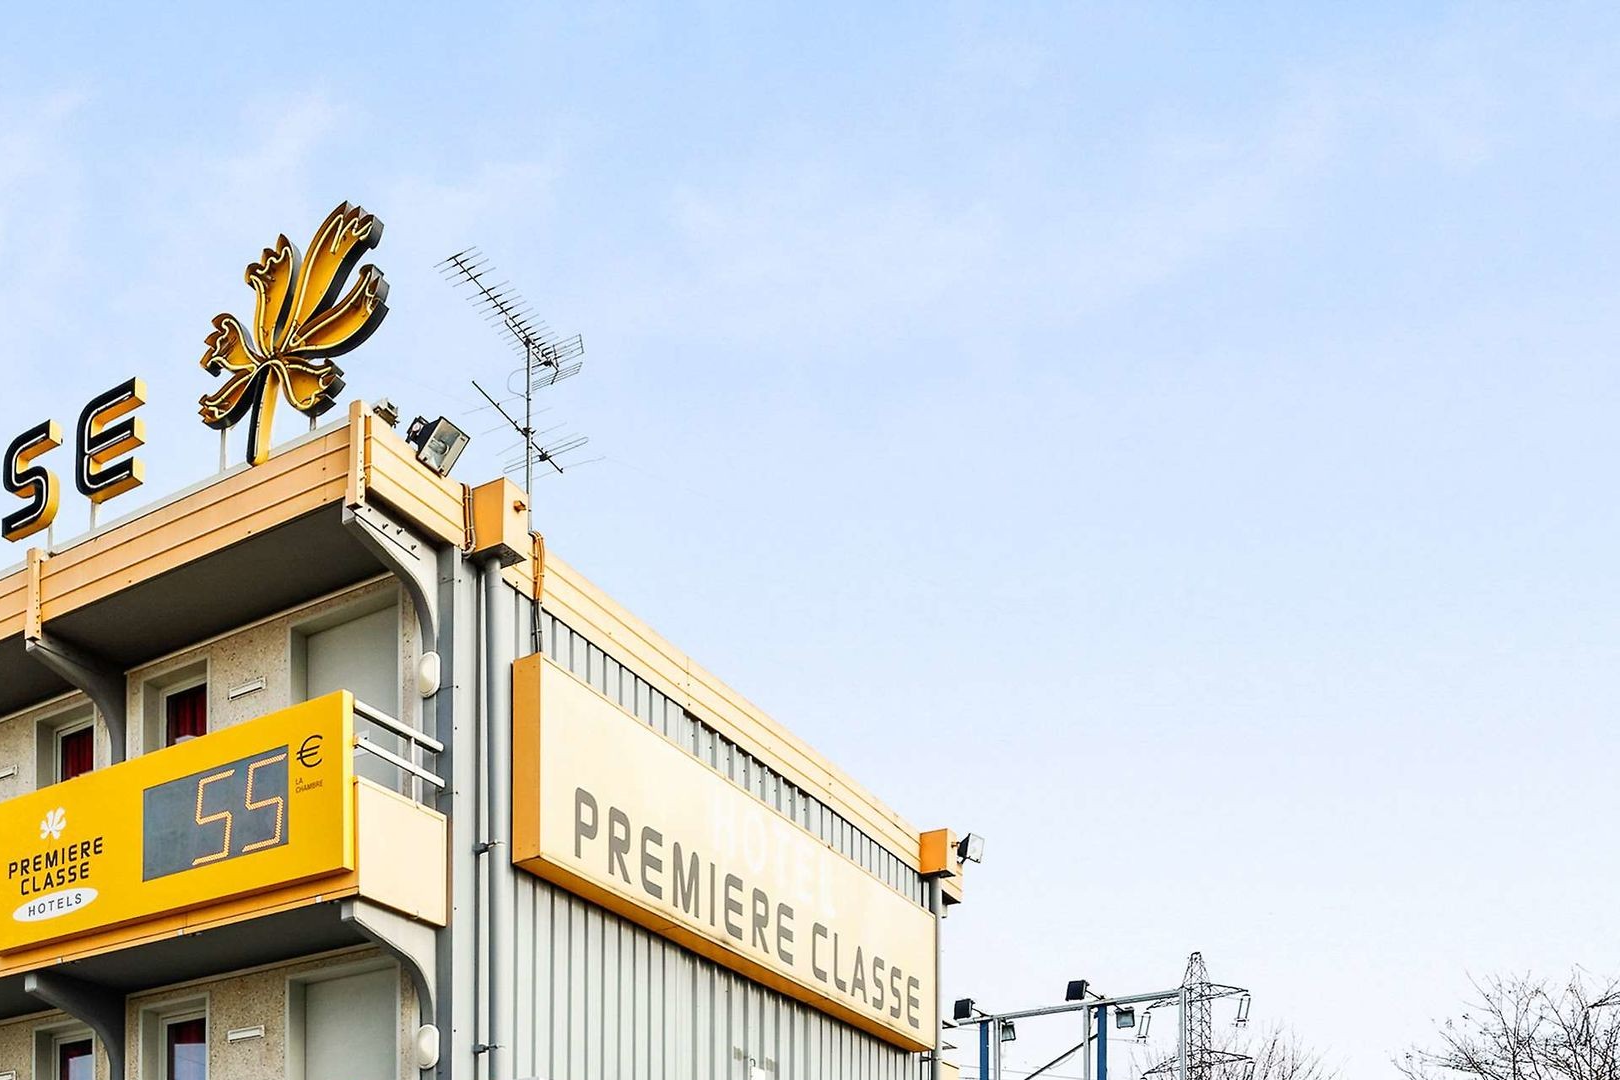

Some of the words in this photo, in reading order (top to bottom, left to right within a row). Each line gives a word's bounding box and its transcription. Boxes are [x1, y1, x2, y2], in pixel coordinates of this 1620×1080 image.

[296, 734, 323, 768] €
[191, 752, 288, 866] 55
[8, 836, 105, 880] PREMIERE
[20, 862, 91, 897] CLASSE
[27, 892, 83, 917] HOTELS
[573, 786, 795, 967] PREMIERE
[811, 921, 921, 1031] CLASSE
